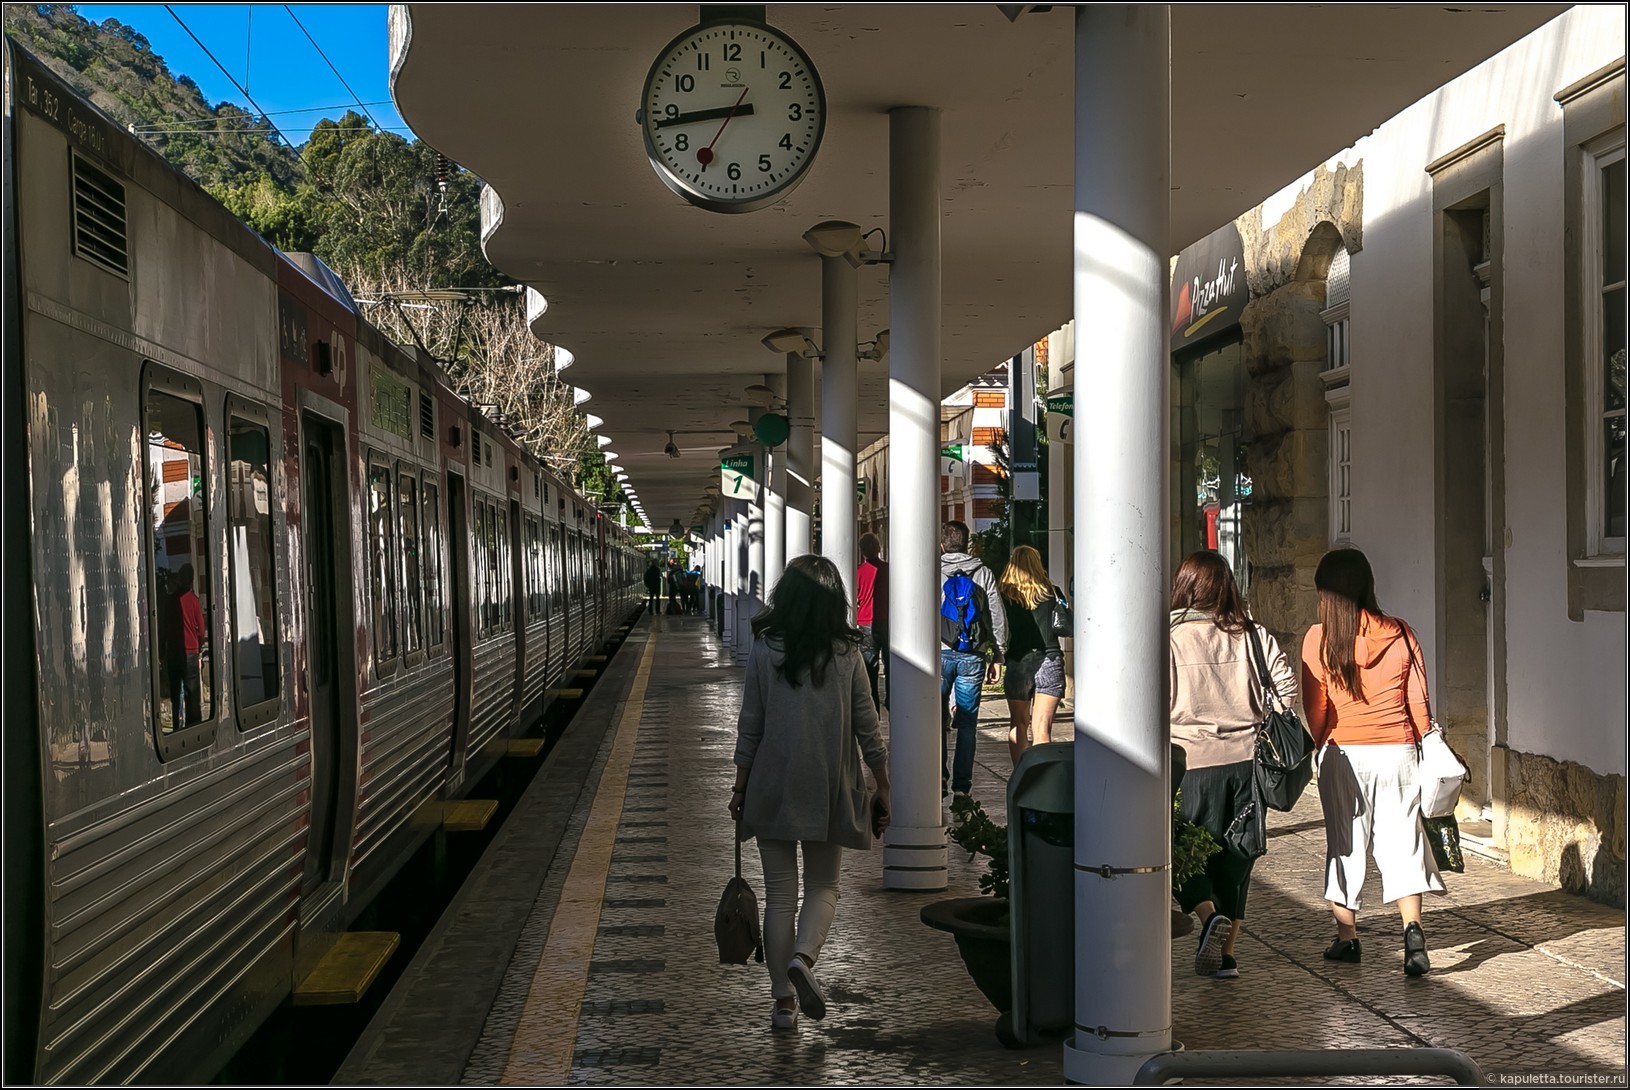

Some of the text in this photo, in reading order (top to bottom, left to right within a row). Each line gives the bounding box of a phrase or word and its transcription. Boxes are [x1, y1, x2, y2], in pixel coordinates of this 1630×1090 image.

[697, 53, 709, 70] 11
[723, 44, 742, 61] 12
[761, 51, 765, 69] 1
[675, 74, 695, 92] 10
[779, 72, 792, 90] 2
[665, 104, 679, 119] 9
[788, 103, 802, 121] 3
[675, 133, 689, 151] 8
[779, 133, 793, 151] 4
[727, 162, 741, 180] 6
[758, 154, 772, 172] 5
[1049, 402, 1074, 412] Telefon
[725, 460, 748, 468] Linha
[733, 475, 743, 494] 1
